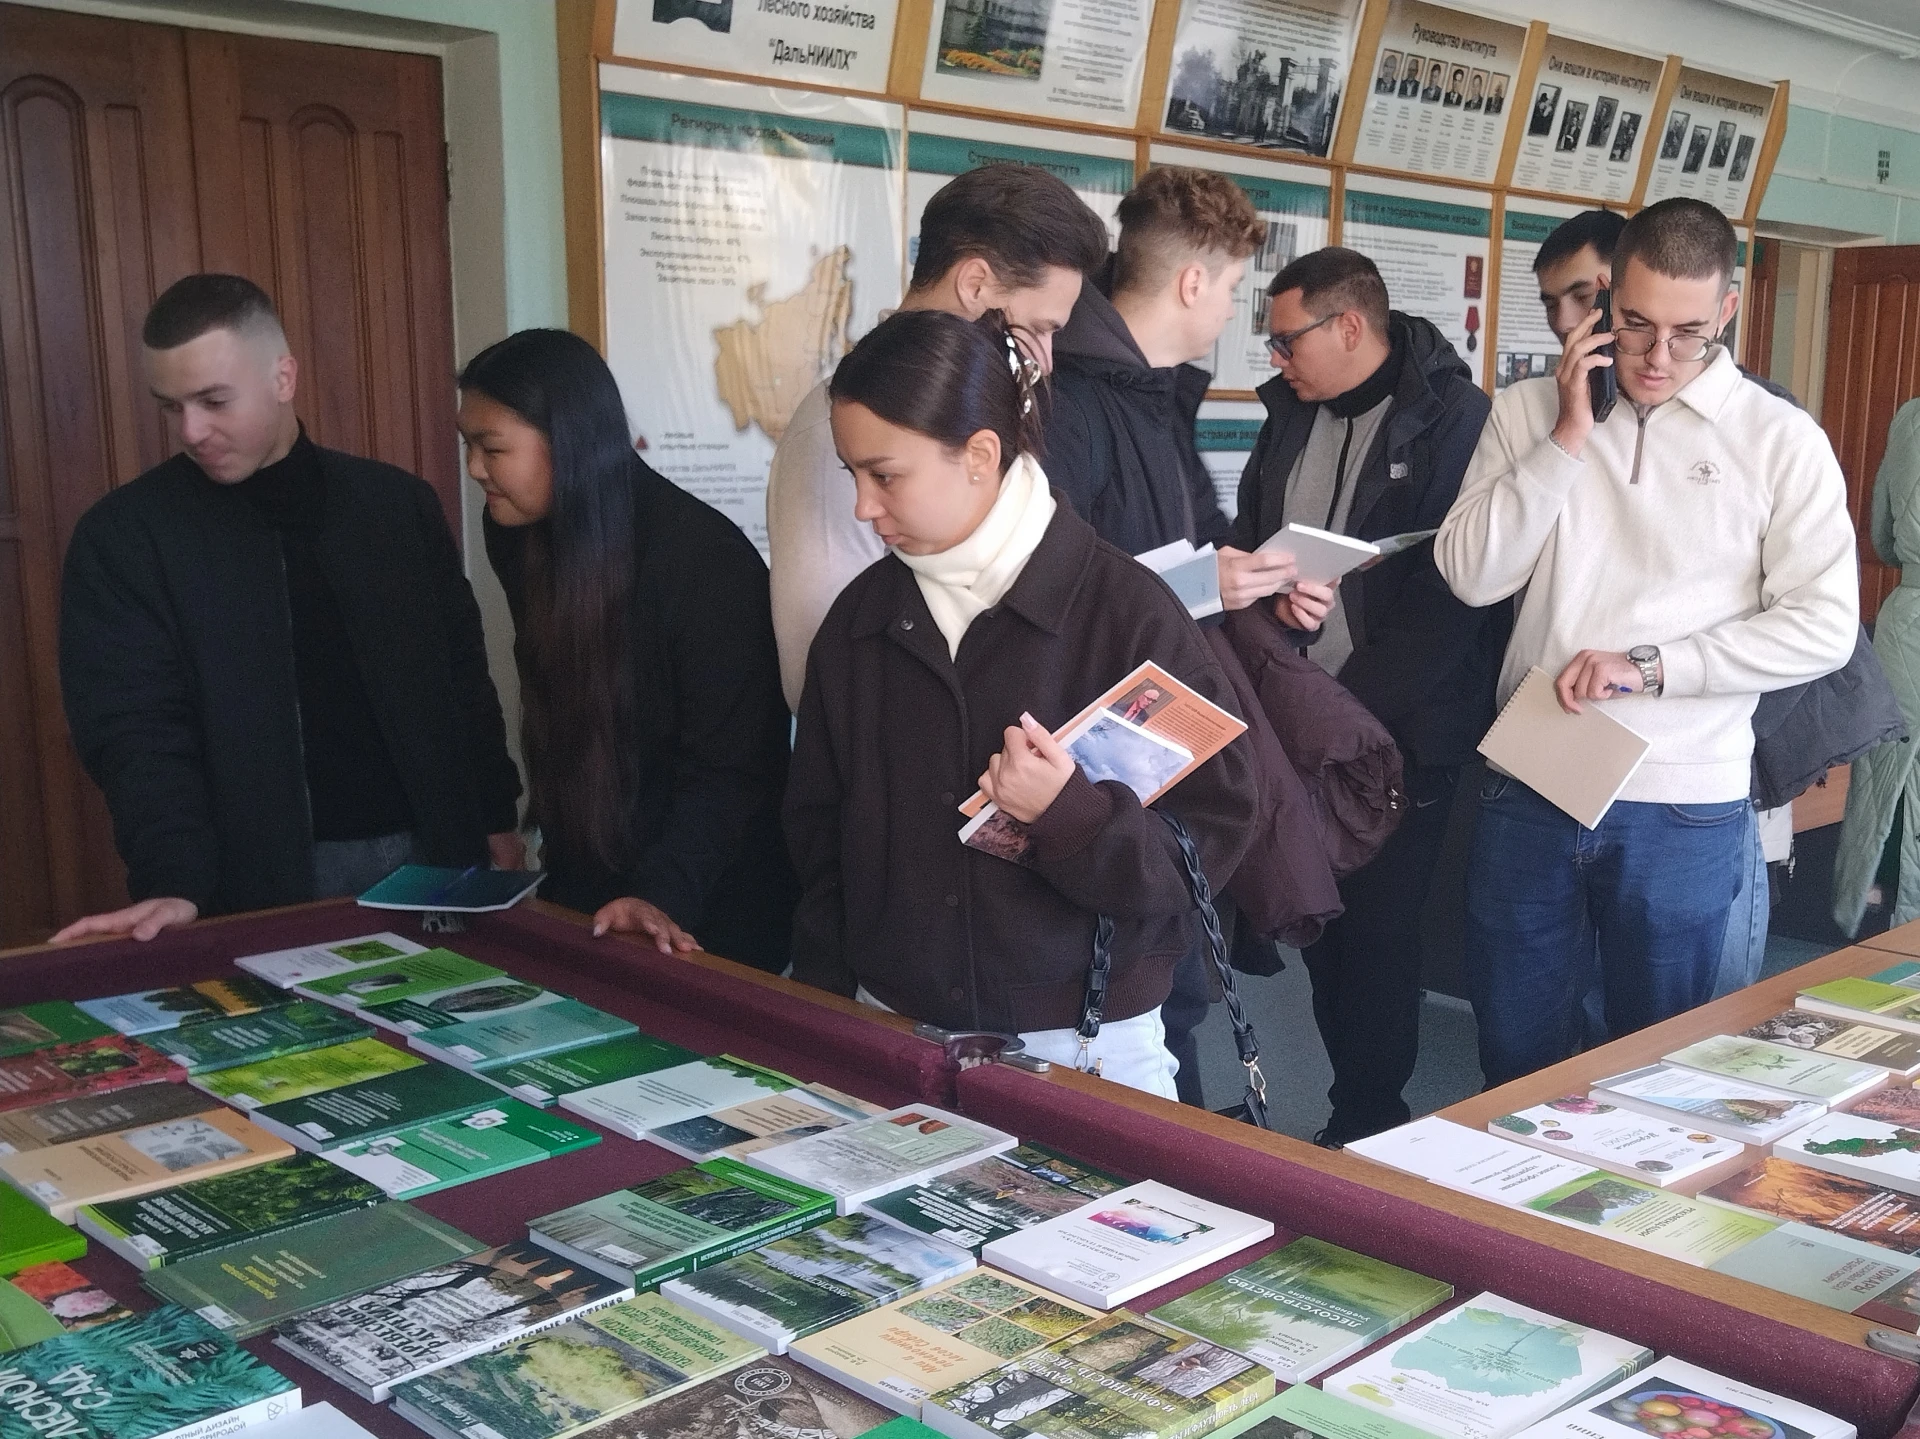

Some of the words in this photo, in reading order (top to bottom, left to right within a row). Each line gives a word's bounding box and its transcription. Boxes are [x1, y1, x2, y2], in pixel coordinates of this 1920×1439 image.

[812, 4, 876, 30] хозяйства
[1411, 22, 1461, 49] Руководство
[1636, 1206, 1697, 1237] РЕКОМЕНДАЦИИ
[1849, 1265, 1902, 1294] ПОЖАРЫ
[1223, 1277, 1362, 1328] ЛЕСОУСТРОЙСТВО
[1285, 1289, 1328, 1306] пособие
[359, 1301, 450, 1352] РАСТЕНИЯ
[1326, 1304, 1372, 1322] Учебное
[334, 1306, 431, 1358] ДРЕВЕСНЫЕ
[1018, 1359, 1078, 1384] ФАУТЫ
[1034, 1351, 1079, 1369] ЛЕСА
[47, 1363, 113, 1411] САД
[1070, 1366, 1166, 1406] ФАУТНОСТЬ
[205, 1415, 240, 1433] ДИЗАЙН
